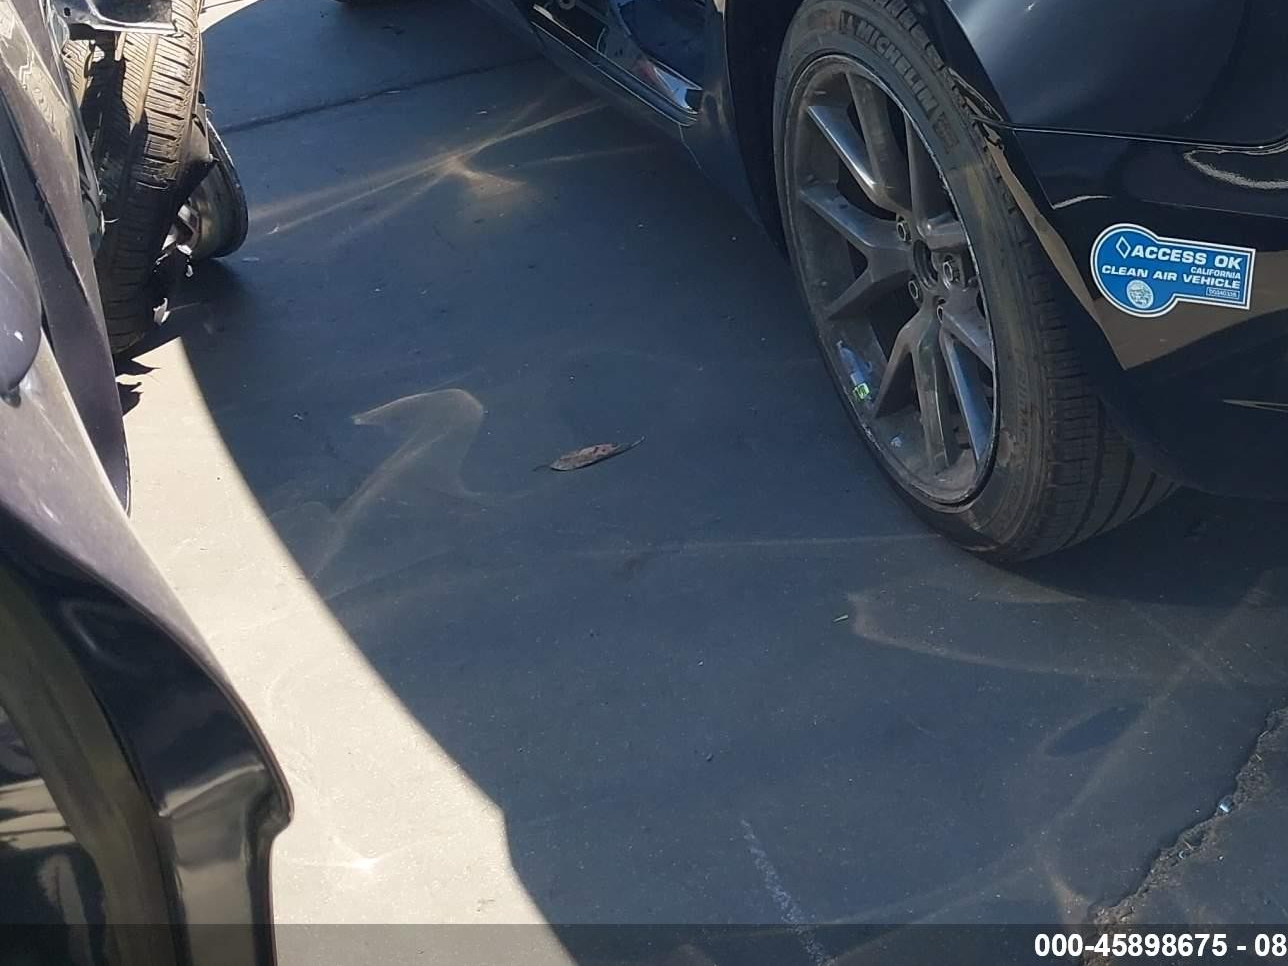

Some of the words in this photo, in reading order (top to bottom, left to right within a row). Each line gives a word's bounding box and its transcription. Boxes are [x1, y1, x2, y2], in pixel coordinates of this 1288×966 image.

[856, 21, 938, 113] MICHELIN
[1131, 244, 1207, 266] ACCESS
[1214, 255, 1243, 270] OK
[1101, 265, 1148, 278] CLEAN
[1153, 270, 1178, 281] AIR
[1183, 273, 1241, 290] VEHICLE
[1190, 266, 1241, 279] CALIFORNIA
